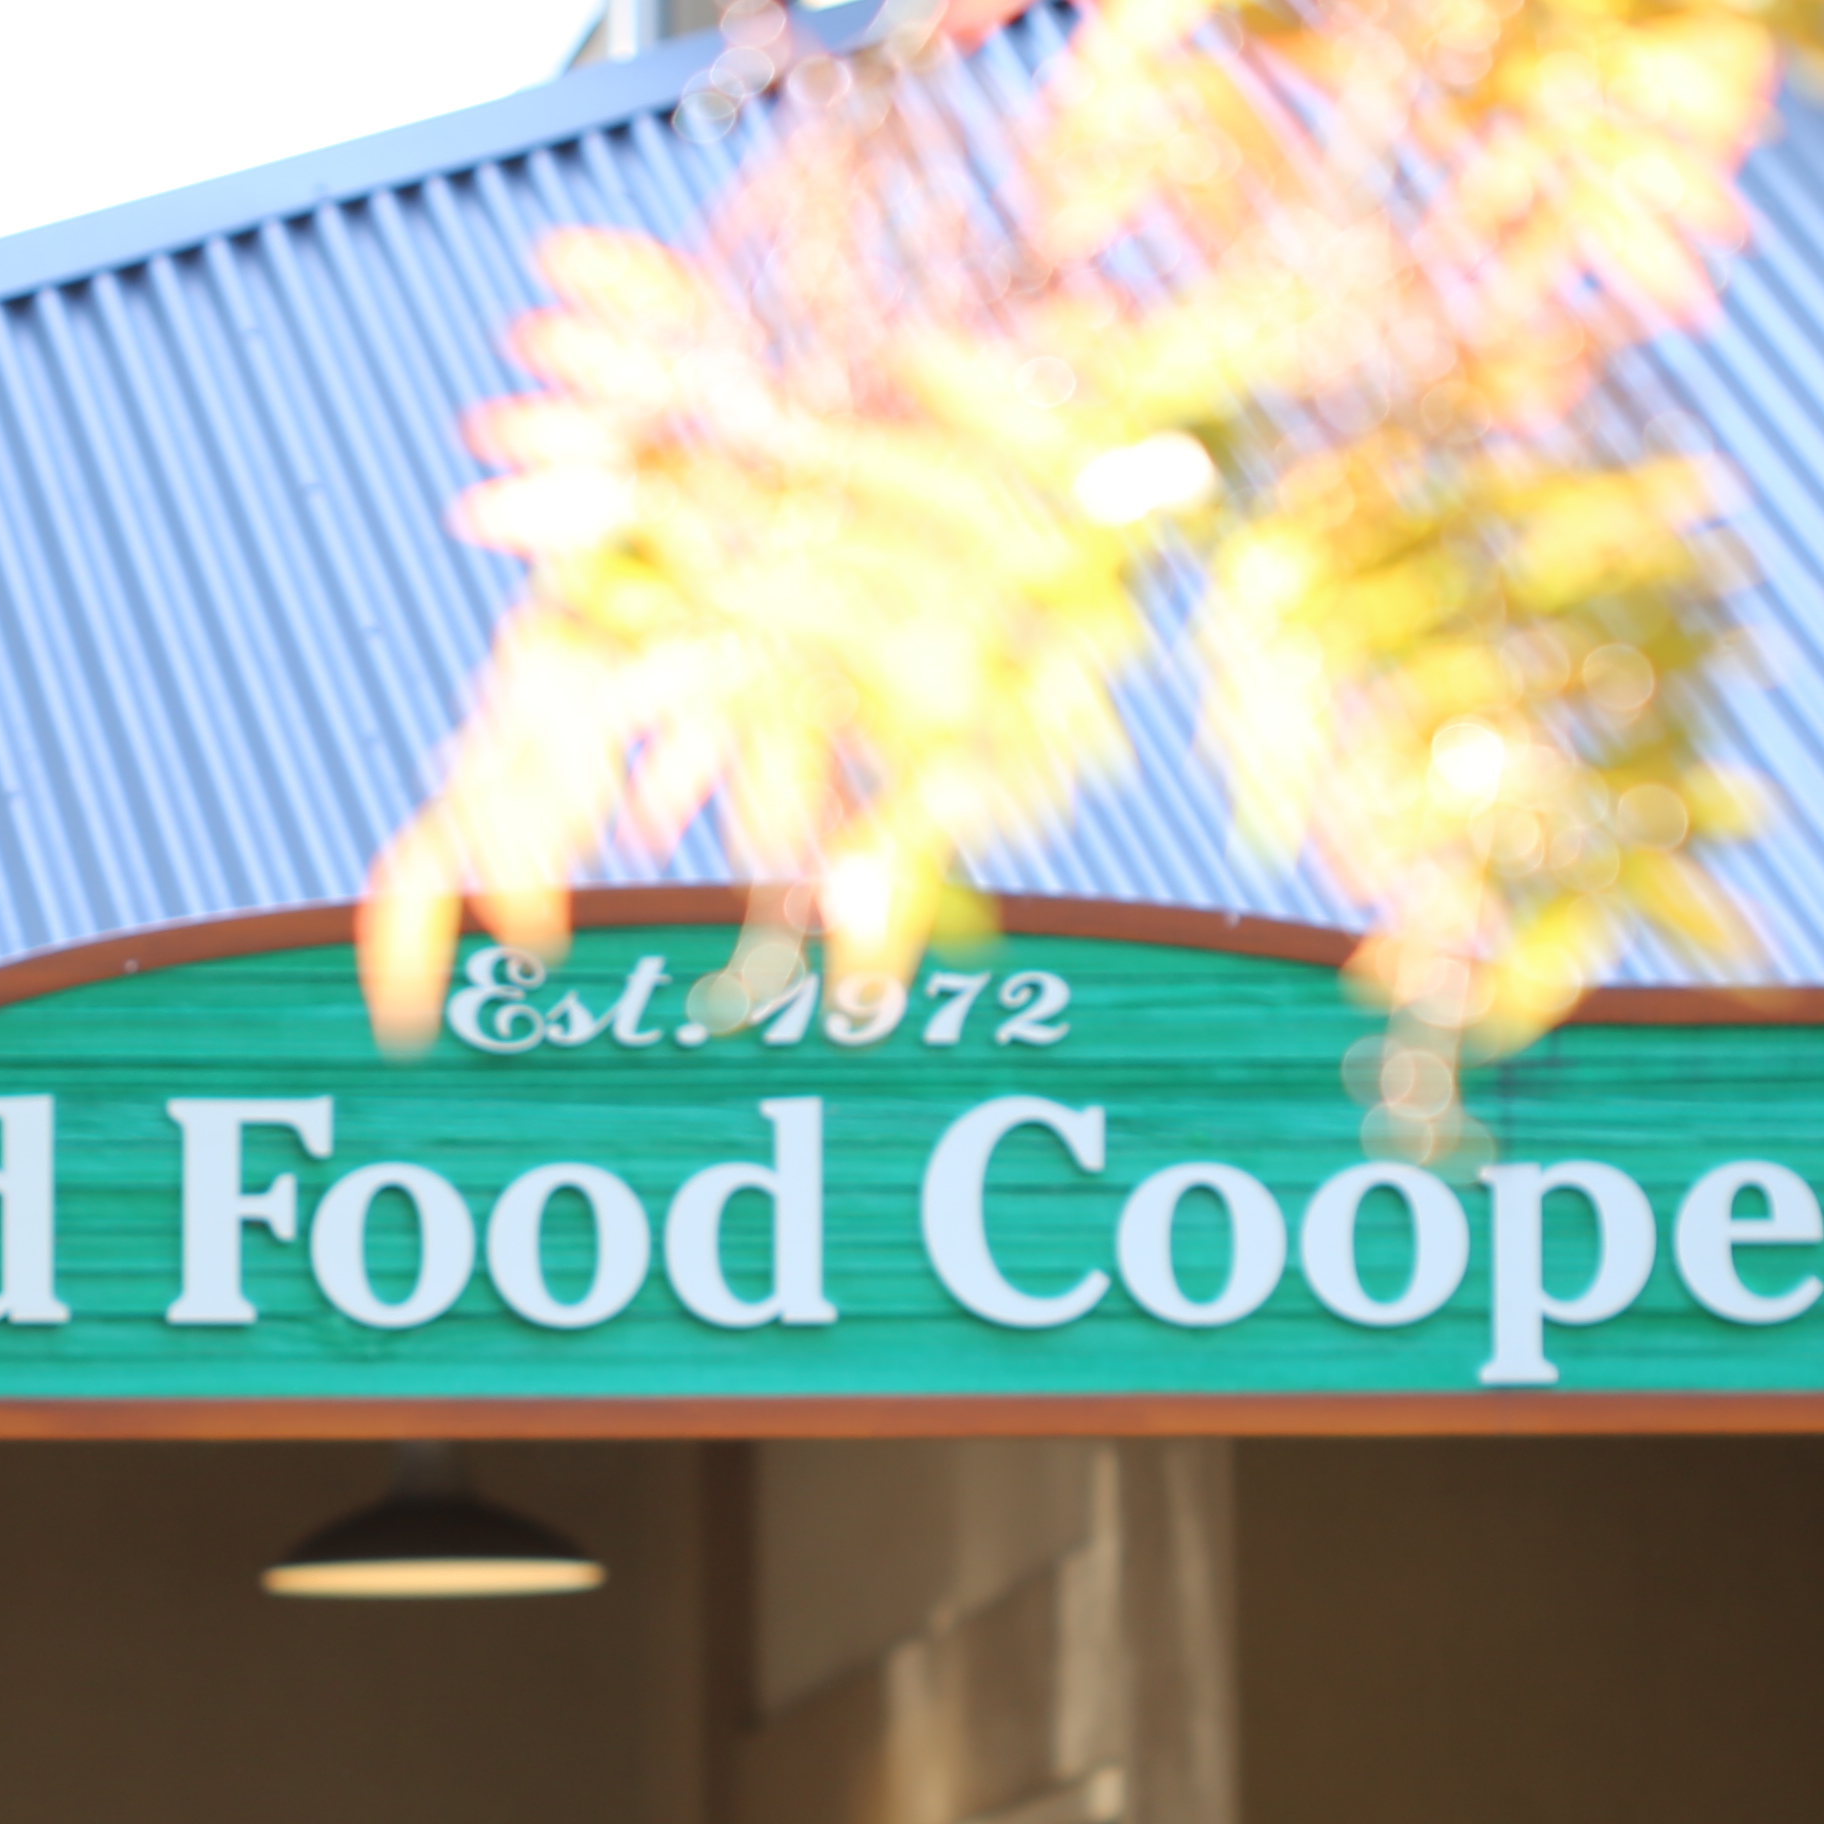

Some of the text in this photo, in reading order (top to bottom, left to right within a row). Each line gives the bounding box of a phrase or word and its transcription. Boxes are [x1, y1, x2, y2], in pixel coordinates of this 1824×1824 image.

[447, 946, 1072, 1054] Est. 1972
[166, 1093, 838, 1328] Food
